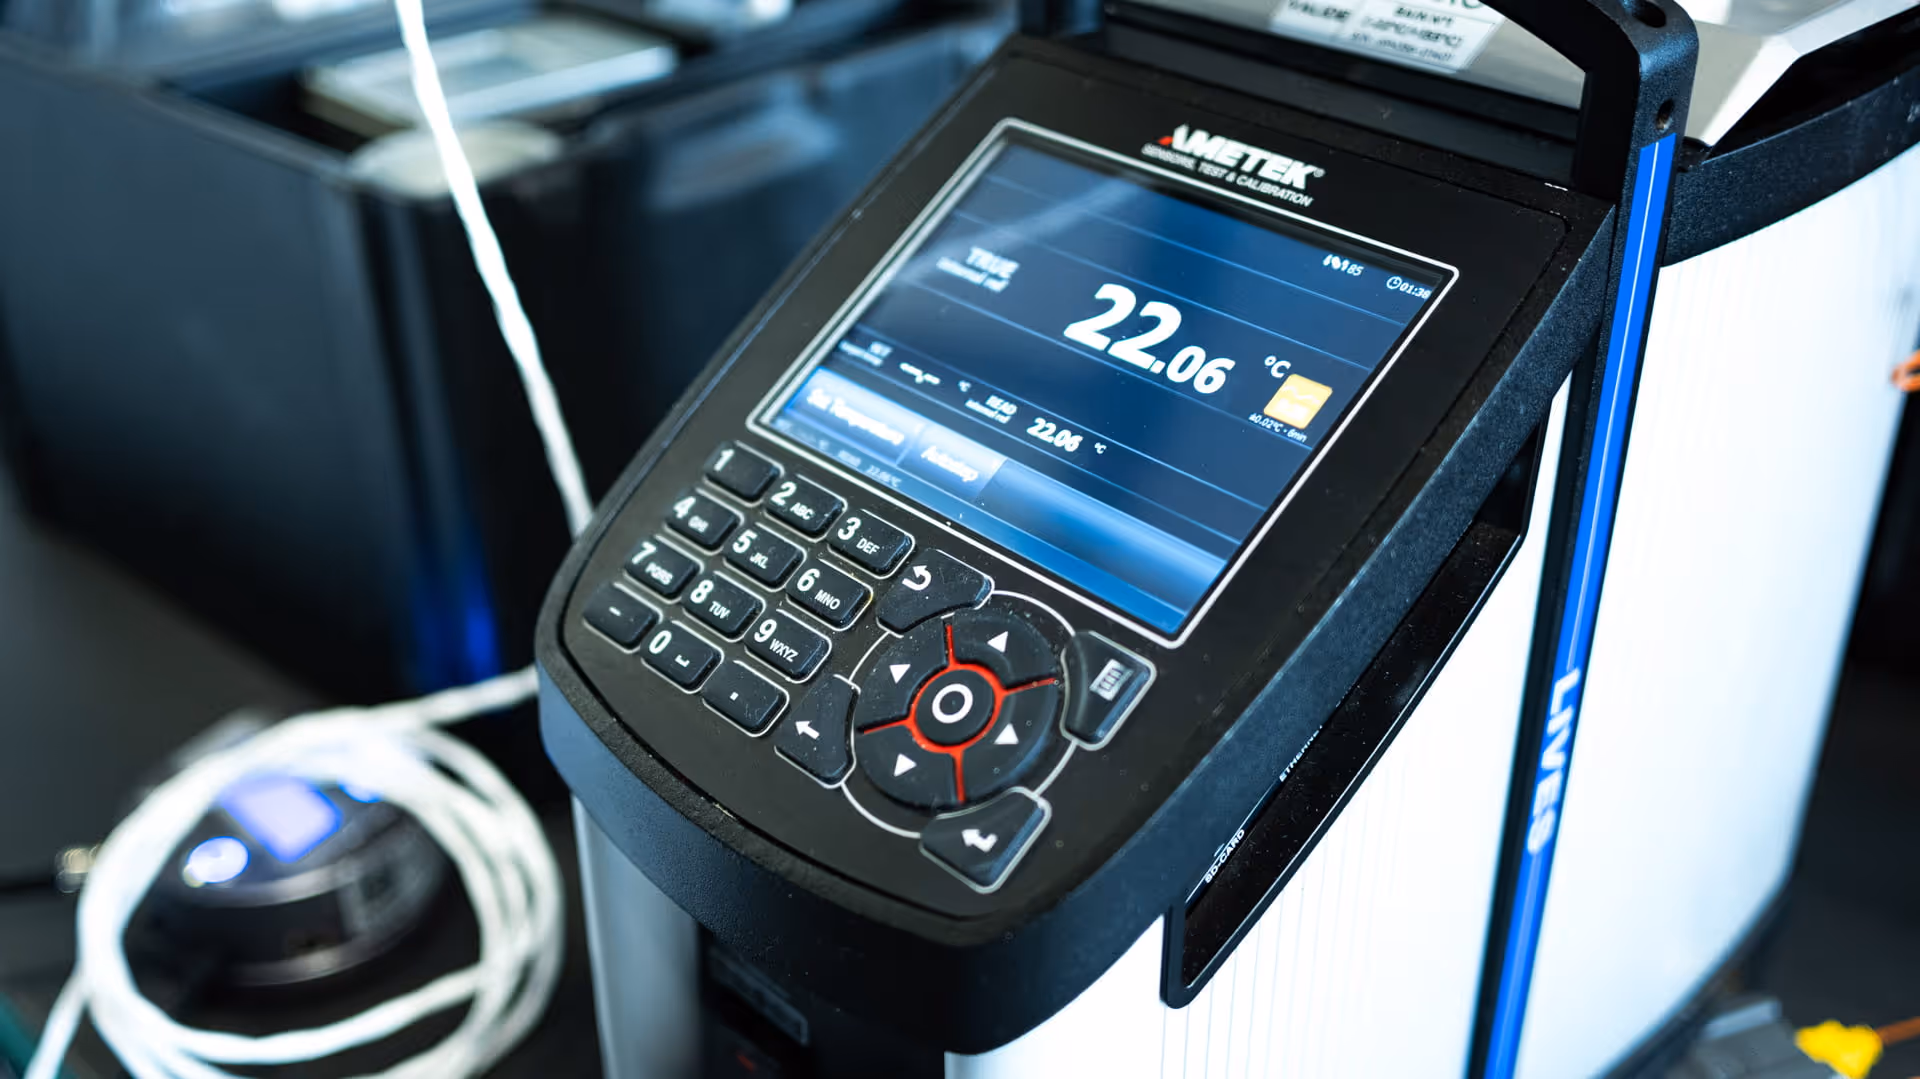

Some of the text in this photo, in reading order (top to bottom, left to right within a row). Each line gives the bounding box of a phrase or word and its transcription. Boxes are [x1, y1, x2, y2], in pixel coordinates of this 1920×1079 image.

[1157, 123, 1314, 190] AMETEK
[1198, 161, 1228, 179] TEST
[1236, 174, 1314, 208] CALIBRATION
[1064, 284, 1236, 394] 22.06
[1026, 417, 1083, 452] 22.06
[713, 448, 734, 471] 1
[673, 496, 696, 519] 4
[771, 481, 815, 520] 2 ABC
[631, 541, 657, 565] 7
[732, 529, 769, 570] 5 JKL
[837, 517, 880, 555] 3 DEF
[690, 579, 731, 619] 8 TUV
[796, 568, 841, 610] 6 MNO
[648, 630, 672, 654] 0
[754, 618, 799, 662] 9 WXYZ
[1204, 828, 1245, 884] SD-CARD
